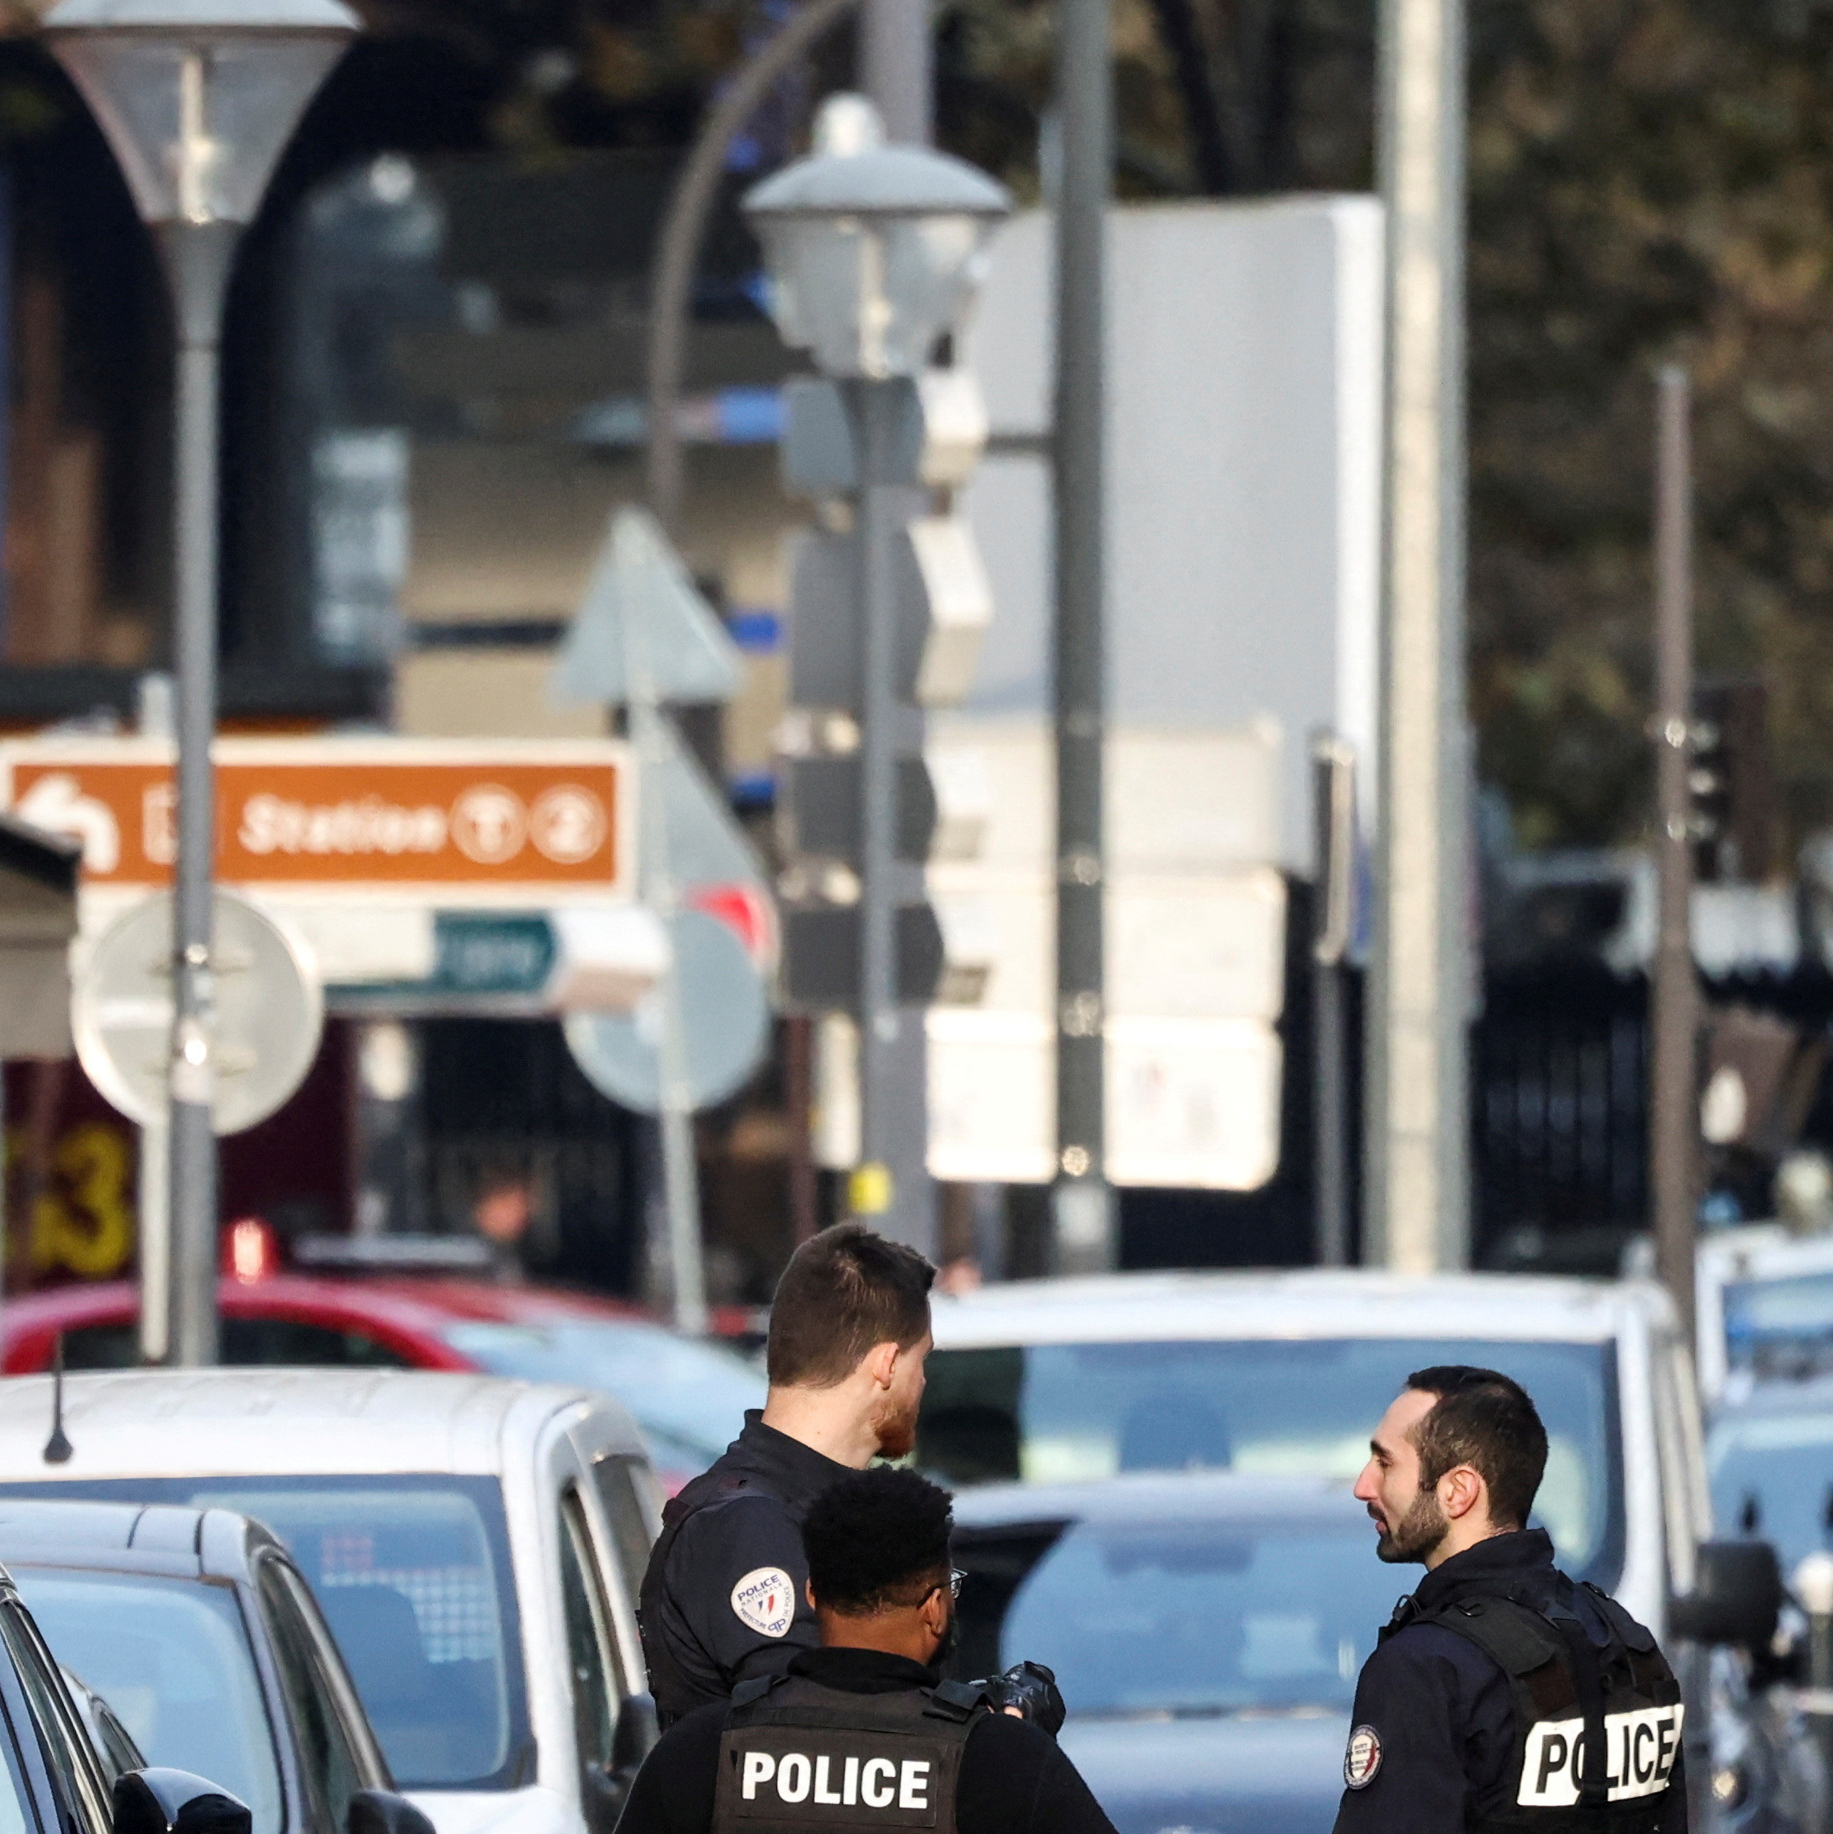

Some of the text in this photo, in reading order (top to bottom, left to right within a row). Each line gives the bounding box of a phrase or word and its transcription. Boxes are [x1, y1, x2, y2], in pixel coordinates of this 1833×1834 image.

[238, 790, 448, 855] Station
[738, 1575, 780, 1601] POLICE
[741, 1582, 784, 1607] NATIONALE
[739, 1749, 931, 1811] POLICE
